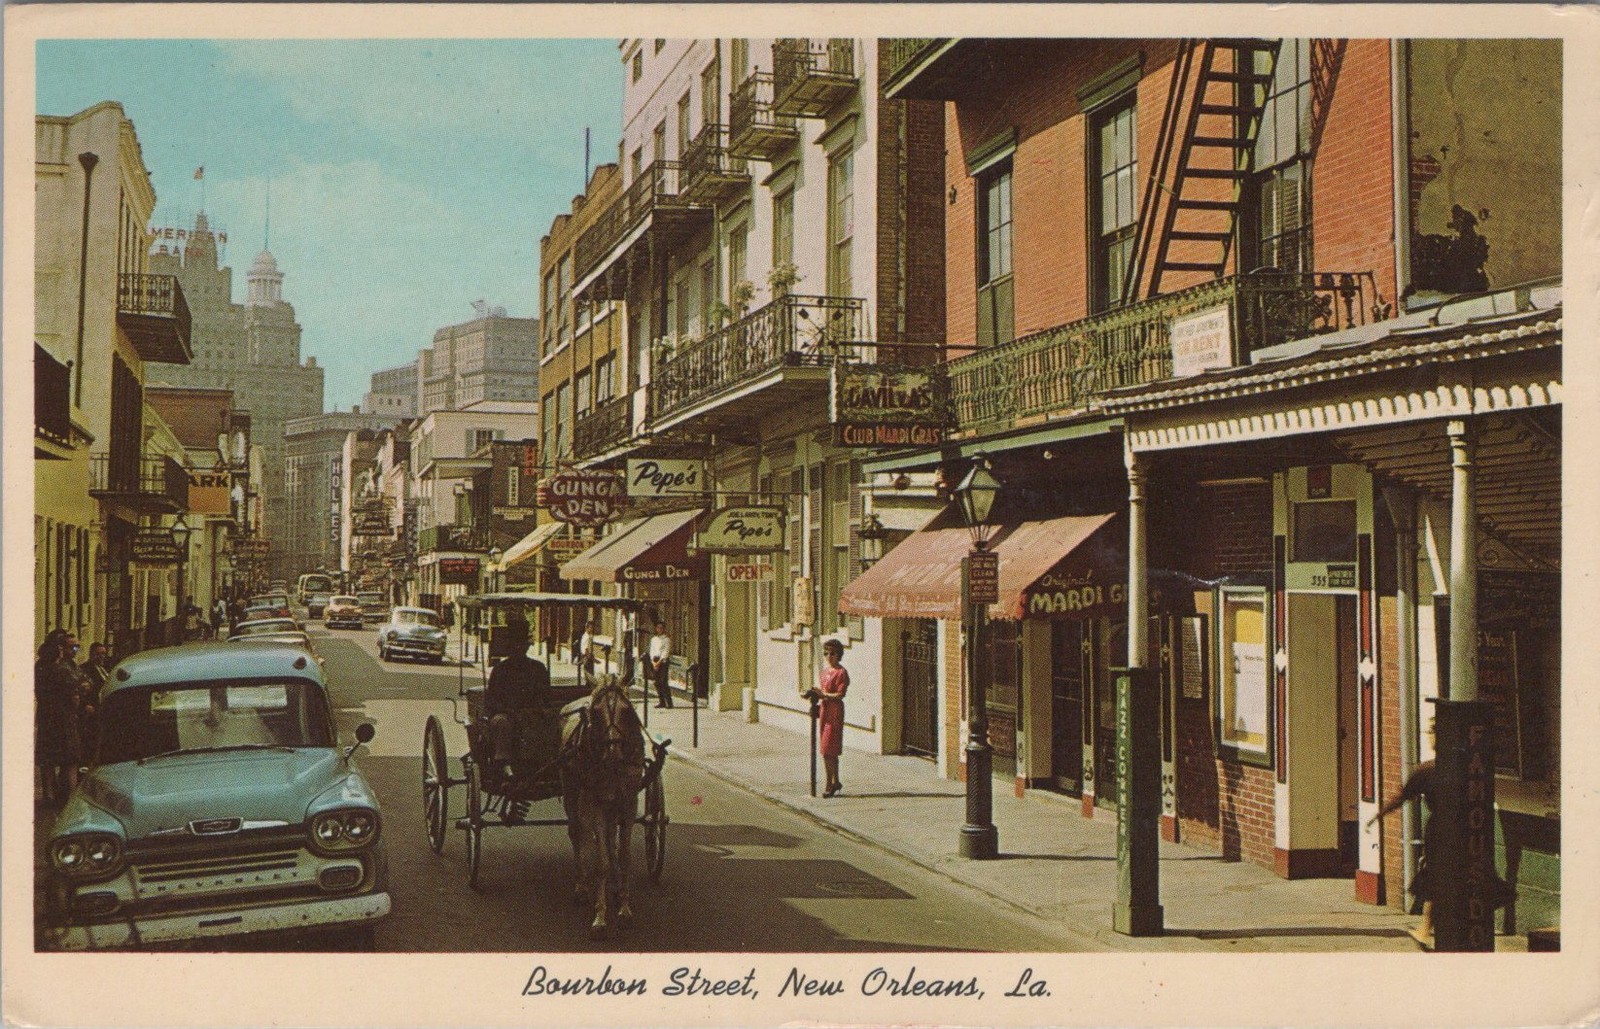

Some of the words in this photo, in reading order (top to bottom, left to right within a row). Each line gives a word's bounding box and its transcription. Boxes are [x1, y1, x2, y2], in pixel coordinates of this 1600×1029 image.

[843, 424, 873, 444] CLUB
[876, 425, 909, 444] MARDI
[911, 423, 939, 444] GRAS
[188, 475, 228, 487] ARK
[633, 461, 697, 494] Pepe's
[552, 480, 619, 497] GUNGA
[331, 460, 340, 541] HOLMES
[567, 499, 609, 516] DEN
[723, 519, 772, 540] Pepe's
[623, 566, 660, 579] GUNGA
[666, 565, 690, 578] DEN
[729, 565, 758, 580] OPEN
[1041, 569, 1093, 588] Original
[1029, 585, 1104, 613] MARDI
[1119, 681, 1127, 739] JAZZ
[138, 871, 298, 895] CHEVROLET
